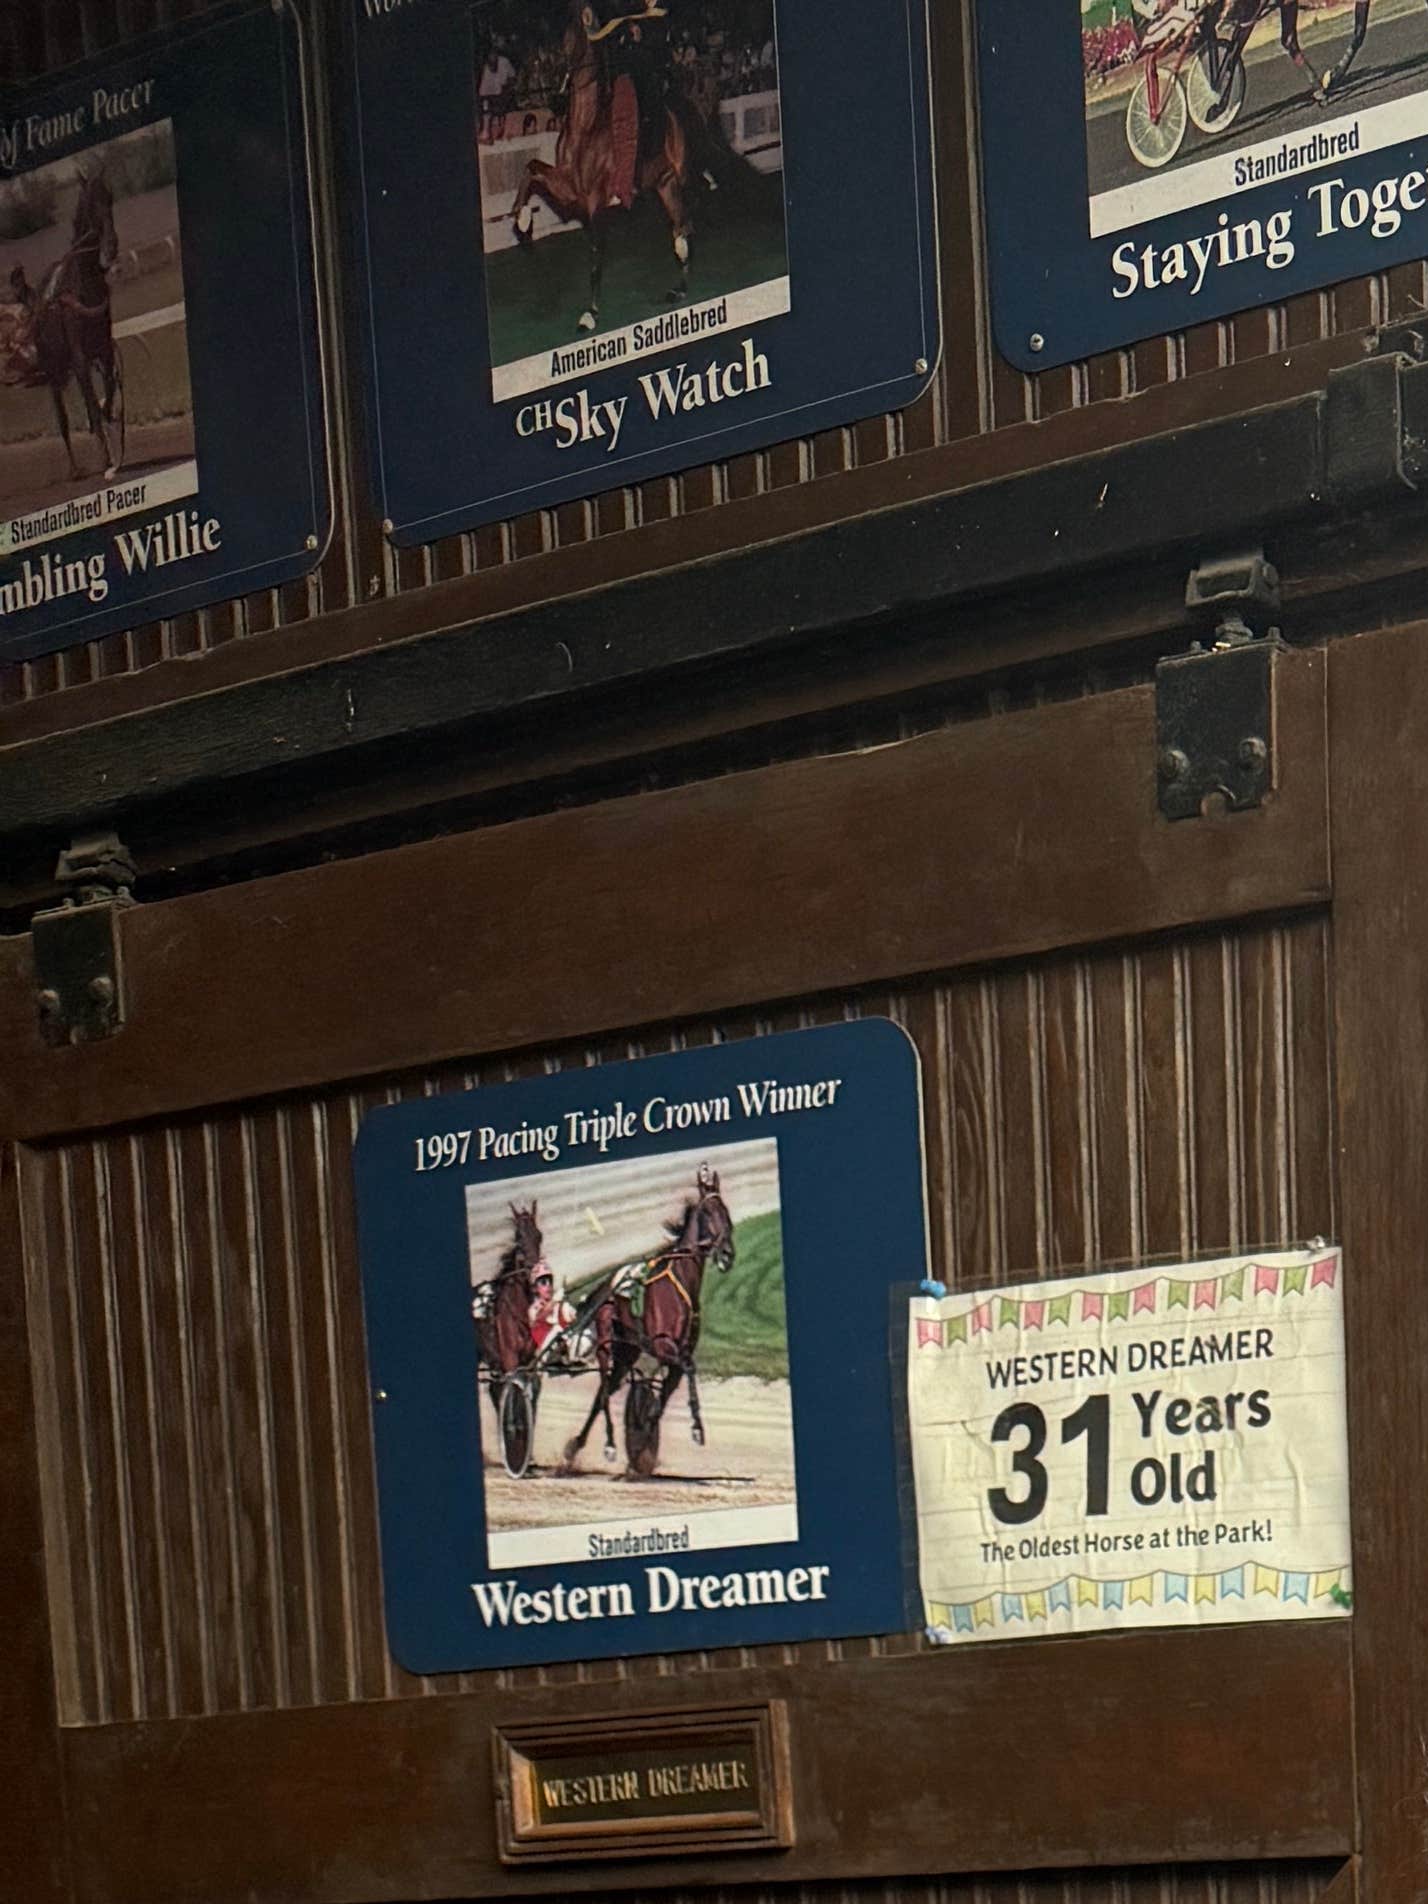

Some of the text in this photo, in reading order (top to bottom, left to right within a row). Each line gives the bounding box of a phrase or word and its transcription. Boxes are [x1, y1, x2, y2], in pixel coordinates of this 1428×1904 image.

[25, 105, 85, 151] Fame
[92, 79, 155, 124] Pacer
[1234, 121, 1361, 188] Standardbred
[1112, 209, 1296, 299] Staying
[551, 297, 728, 378] American Saddlebred
[638, 338, 773, 420] Watch
[11, 484, 147, 544] Standardbred Pacer
[114, 510, 222, 577] Willie
[413, 1078, 842, 1173] 1997 Pacing Triple Crown Winner
[986, 1327, 1274, 1390] WESTERN DREAMER
[985, 1387, 1272, 1526] 31 Years
[1130, 1450, 1217, 1506] Old
[587, 1524, 690, 1559] Standardbred
[980, 1518, 1273, 1564] The Oldest Horse at the Park!
[471, 1564, 830, 1629] Western Dreamer
[543, 1759, 749, 1809] WESTERN DREAMER
